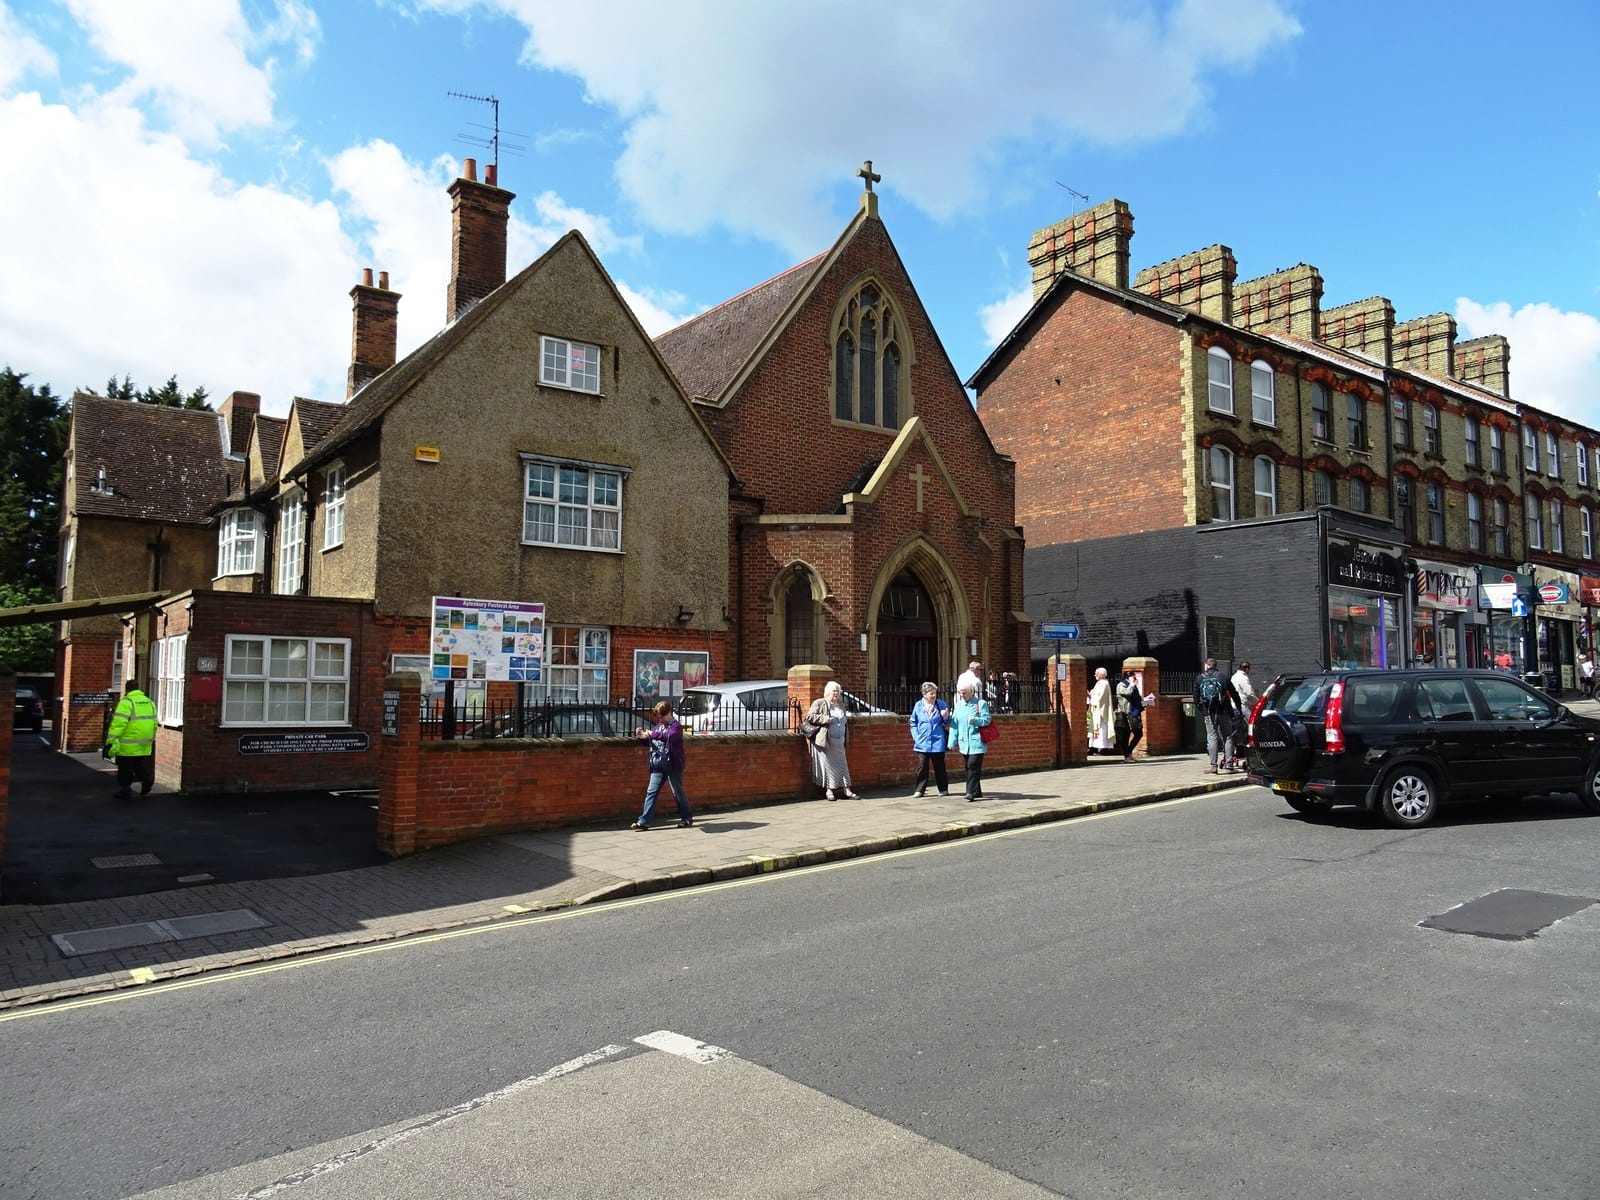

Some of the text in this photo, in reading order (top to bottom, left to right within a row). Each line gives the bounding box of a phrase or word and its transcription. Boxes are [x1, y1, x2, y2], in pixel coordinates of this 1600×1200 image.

[1339, 562, 1354, 578] nail
[463, 600, 487, 608] Aylesbury
[1259, 740, 1286, 748] HONDA
